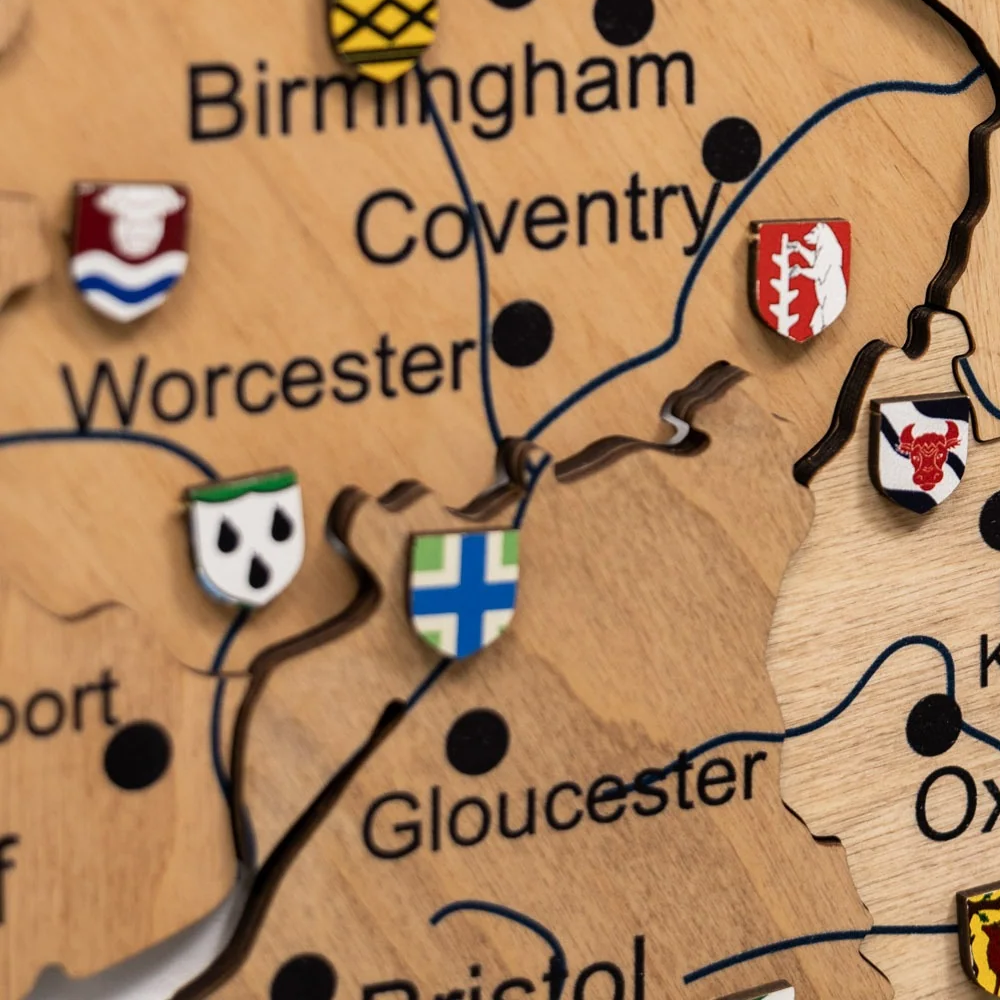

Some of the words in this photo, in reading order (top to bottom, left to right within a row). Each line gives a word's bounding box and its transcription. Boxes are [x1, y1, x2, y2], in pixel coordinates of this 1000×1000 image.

[187, 42, 697, 143] Birmingham
[355, 172, 721, 266] Coventry
[60, 332, 478, 435] Worcester
[362, 748, 767, 862] Gloucester
